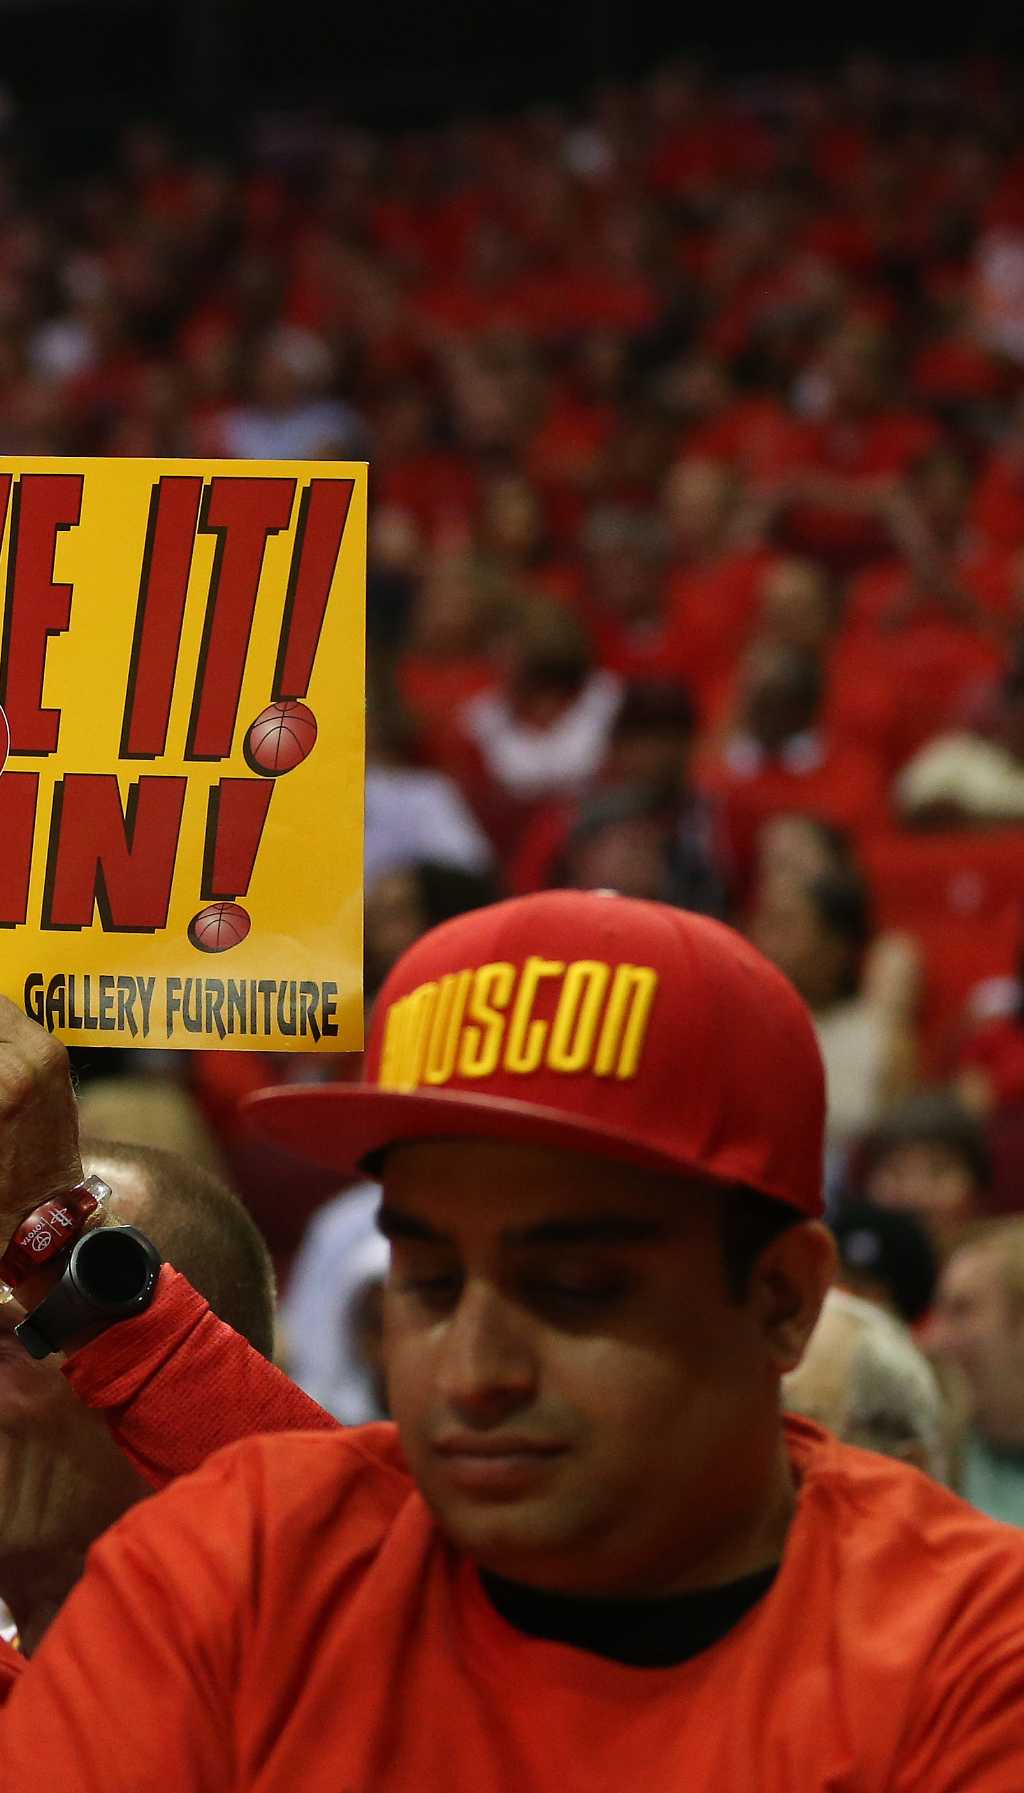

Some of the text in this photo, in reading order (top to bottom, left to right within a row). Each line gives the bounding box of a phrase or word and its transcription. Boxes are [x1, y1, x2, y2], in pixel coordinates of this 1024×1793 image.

[118, 476, 355, 777] IT!
[24, 973, 338, 1043] GALLERY FURNITURE
